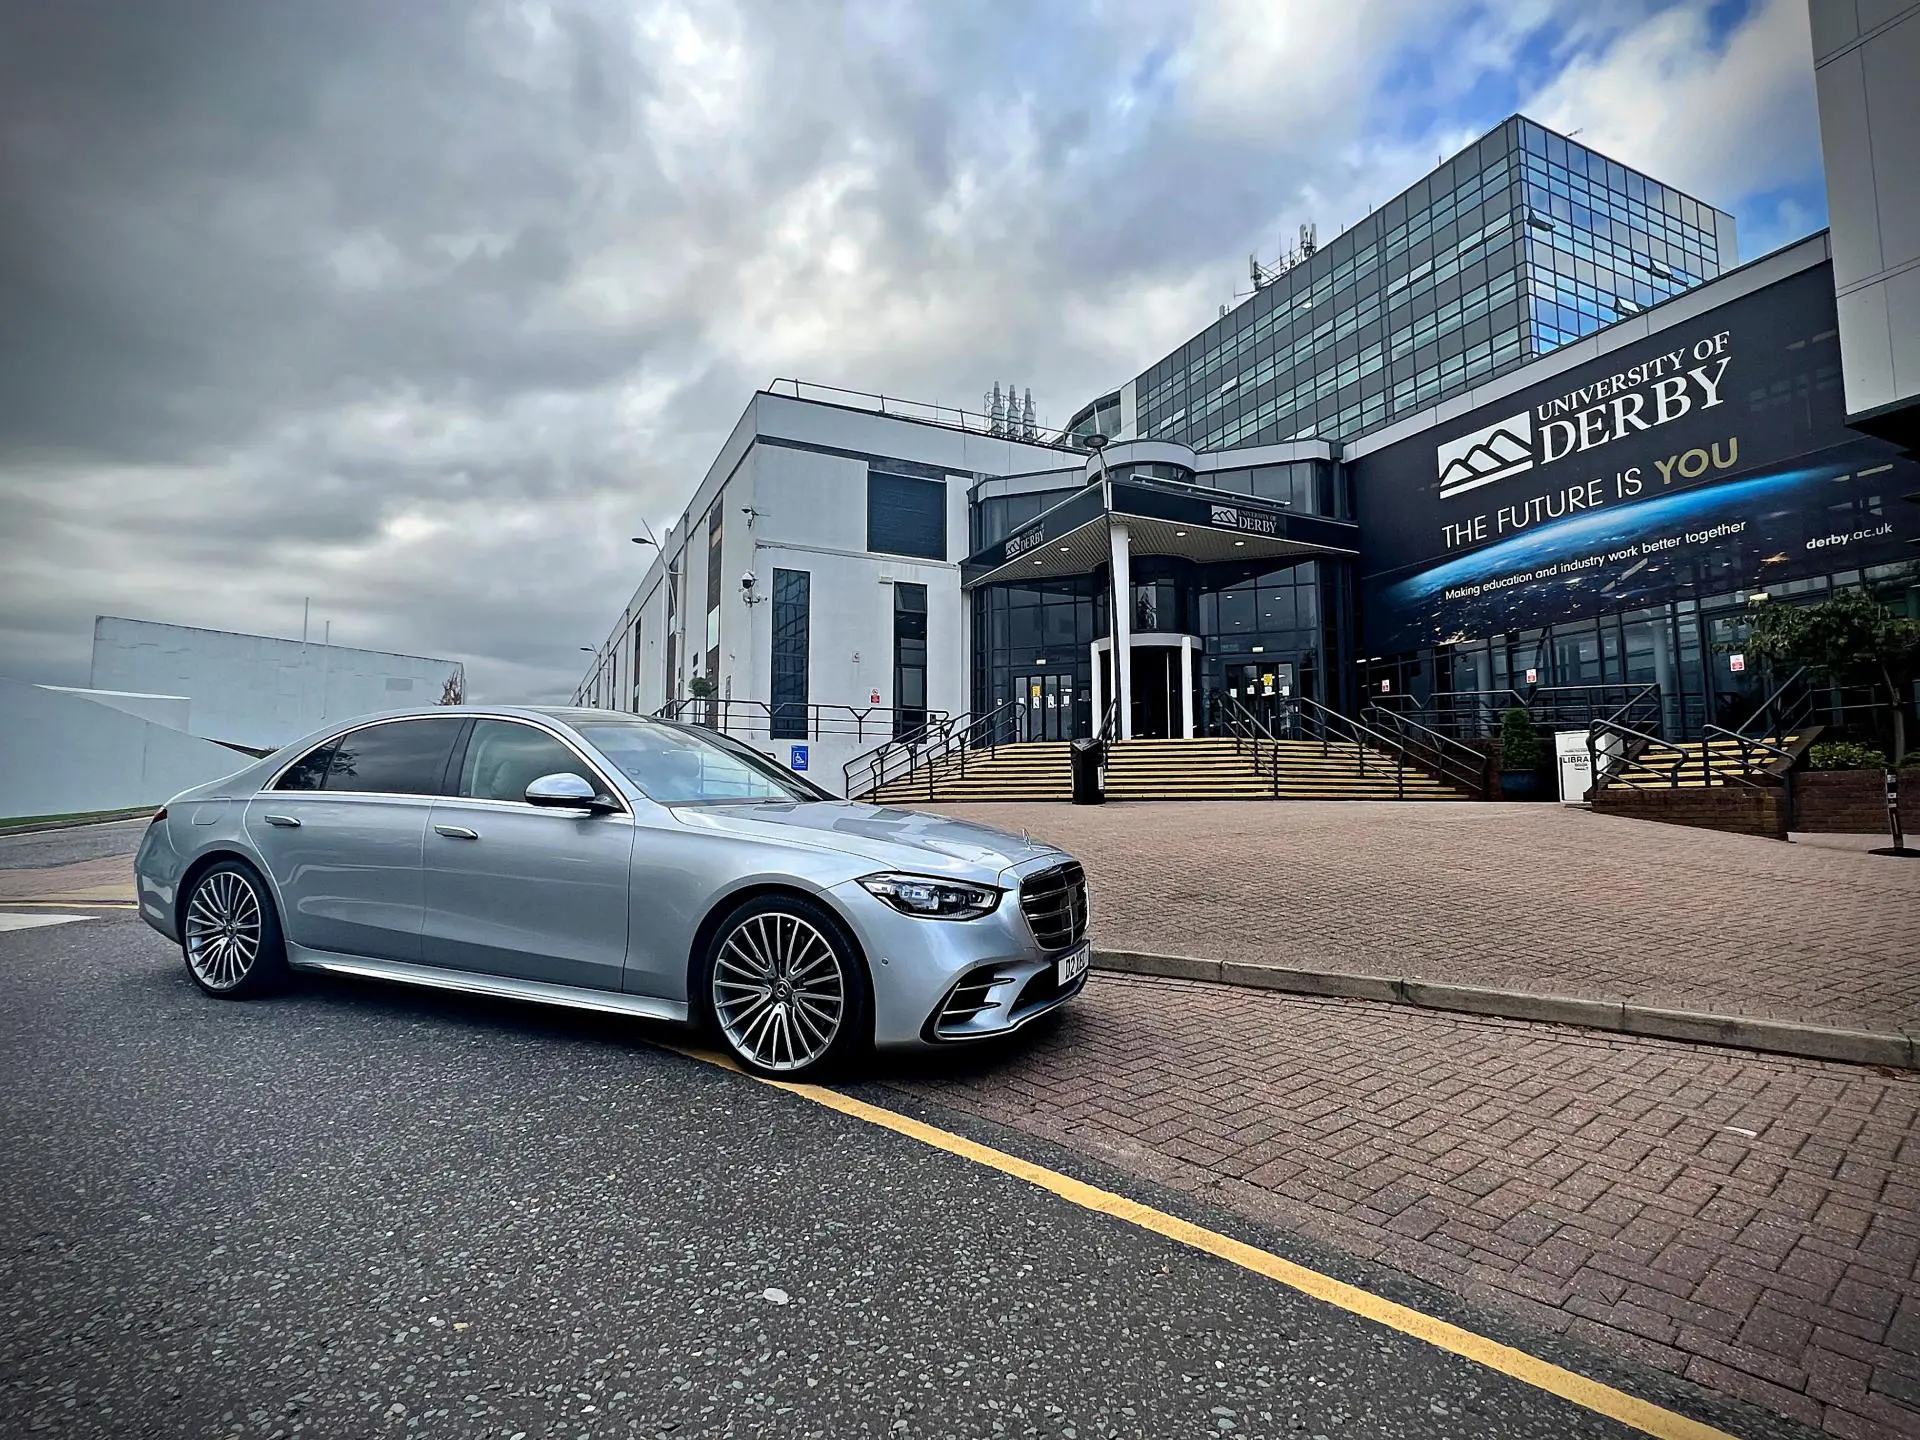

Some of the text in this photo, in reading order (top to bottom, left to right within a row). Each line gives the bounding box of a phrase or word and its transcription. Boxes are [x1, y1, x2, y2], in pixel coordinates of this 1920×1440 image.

[1537, 331, 1730, 421] UNIVERSITY OF
[1538, 356, 1732, 466] DERBY
[1239, 516, 1277, 534] DERBY
[1441, 437, 1738, 549] THE FUTURE IS YOU
[1020, 528, 1045, 552] DERBY
[1445, 521, 1747, 600] Making education and industry work better together
[1806, 522, 1893, 550] derby.ac.uk
